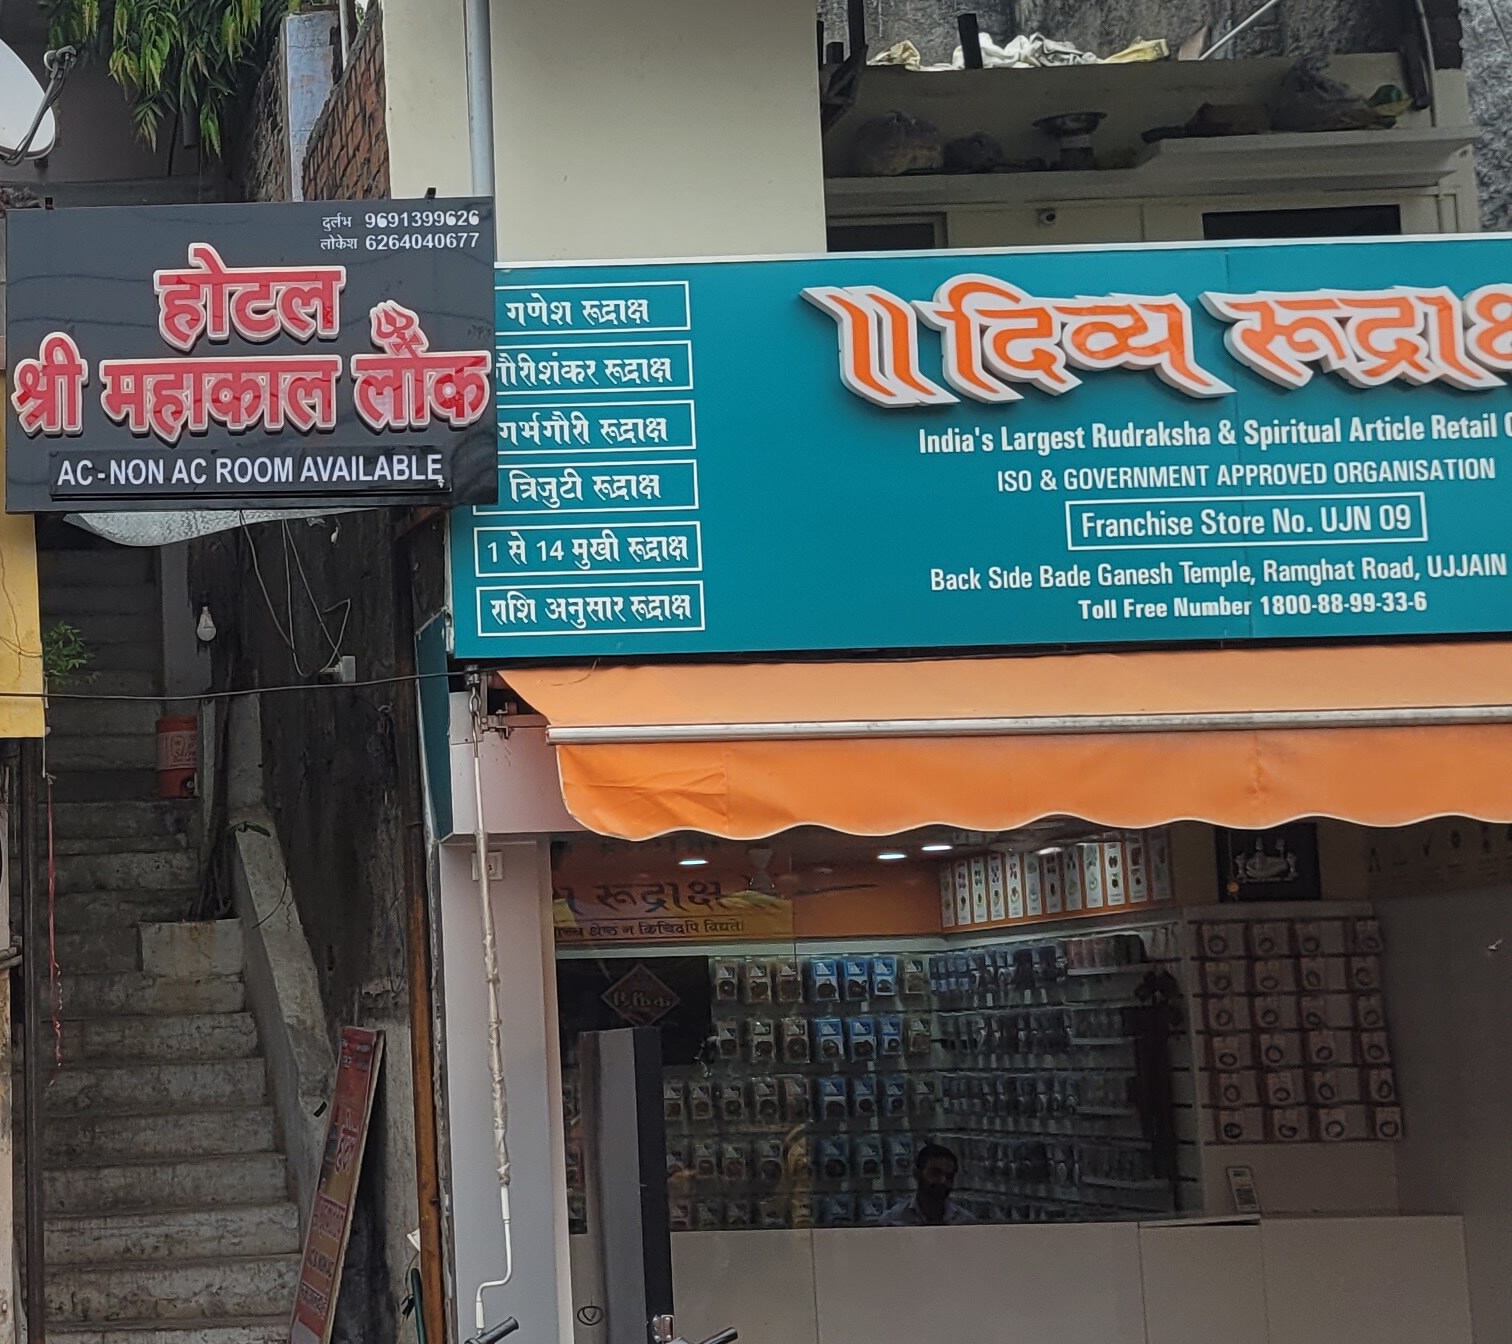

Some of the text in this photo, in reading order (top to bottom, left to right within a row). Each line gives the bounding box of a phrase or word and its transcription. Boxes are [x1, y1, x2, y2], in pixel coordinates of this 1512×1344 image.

[322, 210, 480, 231] दुर्लभ 9691399626
[320, 232, 480, 250] लोकेश 6264040677
[153, 242, 346, 351] होटल
[506, 293, 572, 326] गणेश
[11, 299, 492, 444] श्री महाकाल लोक
[496, 351, 599, 386] गौरीशंकर
[498, 410, 590, 446] गर्भगौरी
[919, 428, 993, 454] India's
[1001, 426, 1086, 456] Largest
[1092, 421, 1211, 449] Rudraksha
[1218, 420, 1236, 445] &
[1243, 417, 1341, 451] Spiritual
[1349, 415, 1425, 443] Article
[1431, 412, 1497, 439] Retail
[171, 457, 207, 483] AC
[216, 456, 293, 484] ROOM
[300, 454, 444, 484] AVAILABLE
[997, 457, 1496, 492] ISO & GOVERNMENT APPROVED ORGANISATION
[509, 468, 584, 508] त्रिजुटी
[1081, 504, 1412, 538] Franchise Store No. UJN 09
[487, 542, 497, 563] 1
[508, 531, 528, 565] से
[536, 540, 565, 561] 14
[572, 529, 620, 570] मुखी
[930, 553, 1507, 591] Back Side Bade Ganesh Temple, Ramghat Road, UJJAIN
[490, 591, 537, 625] राशि
[545, 597, 625, 629] अनुसार
[1078, 592, 1428, 620] Toll Free Number 1800-88-99-33-6
